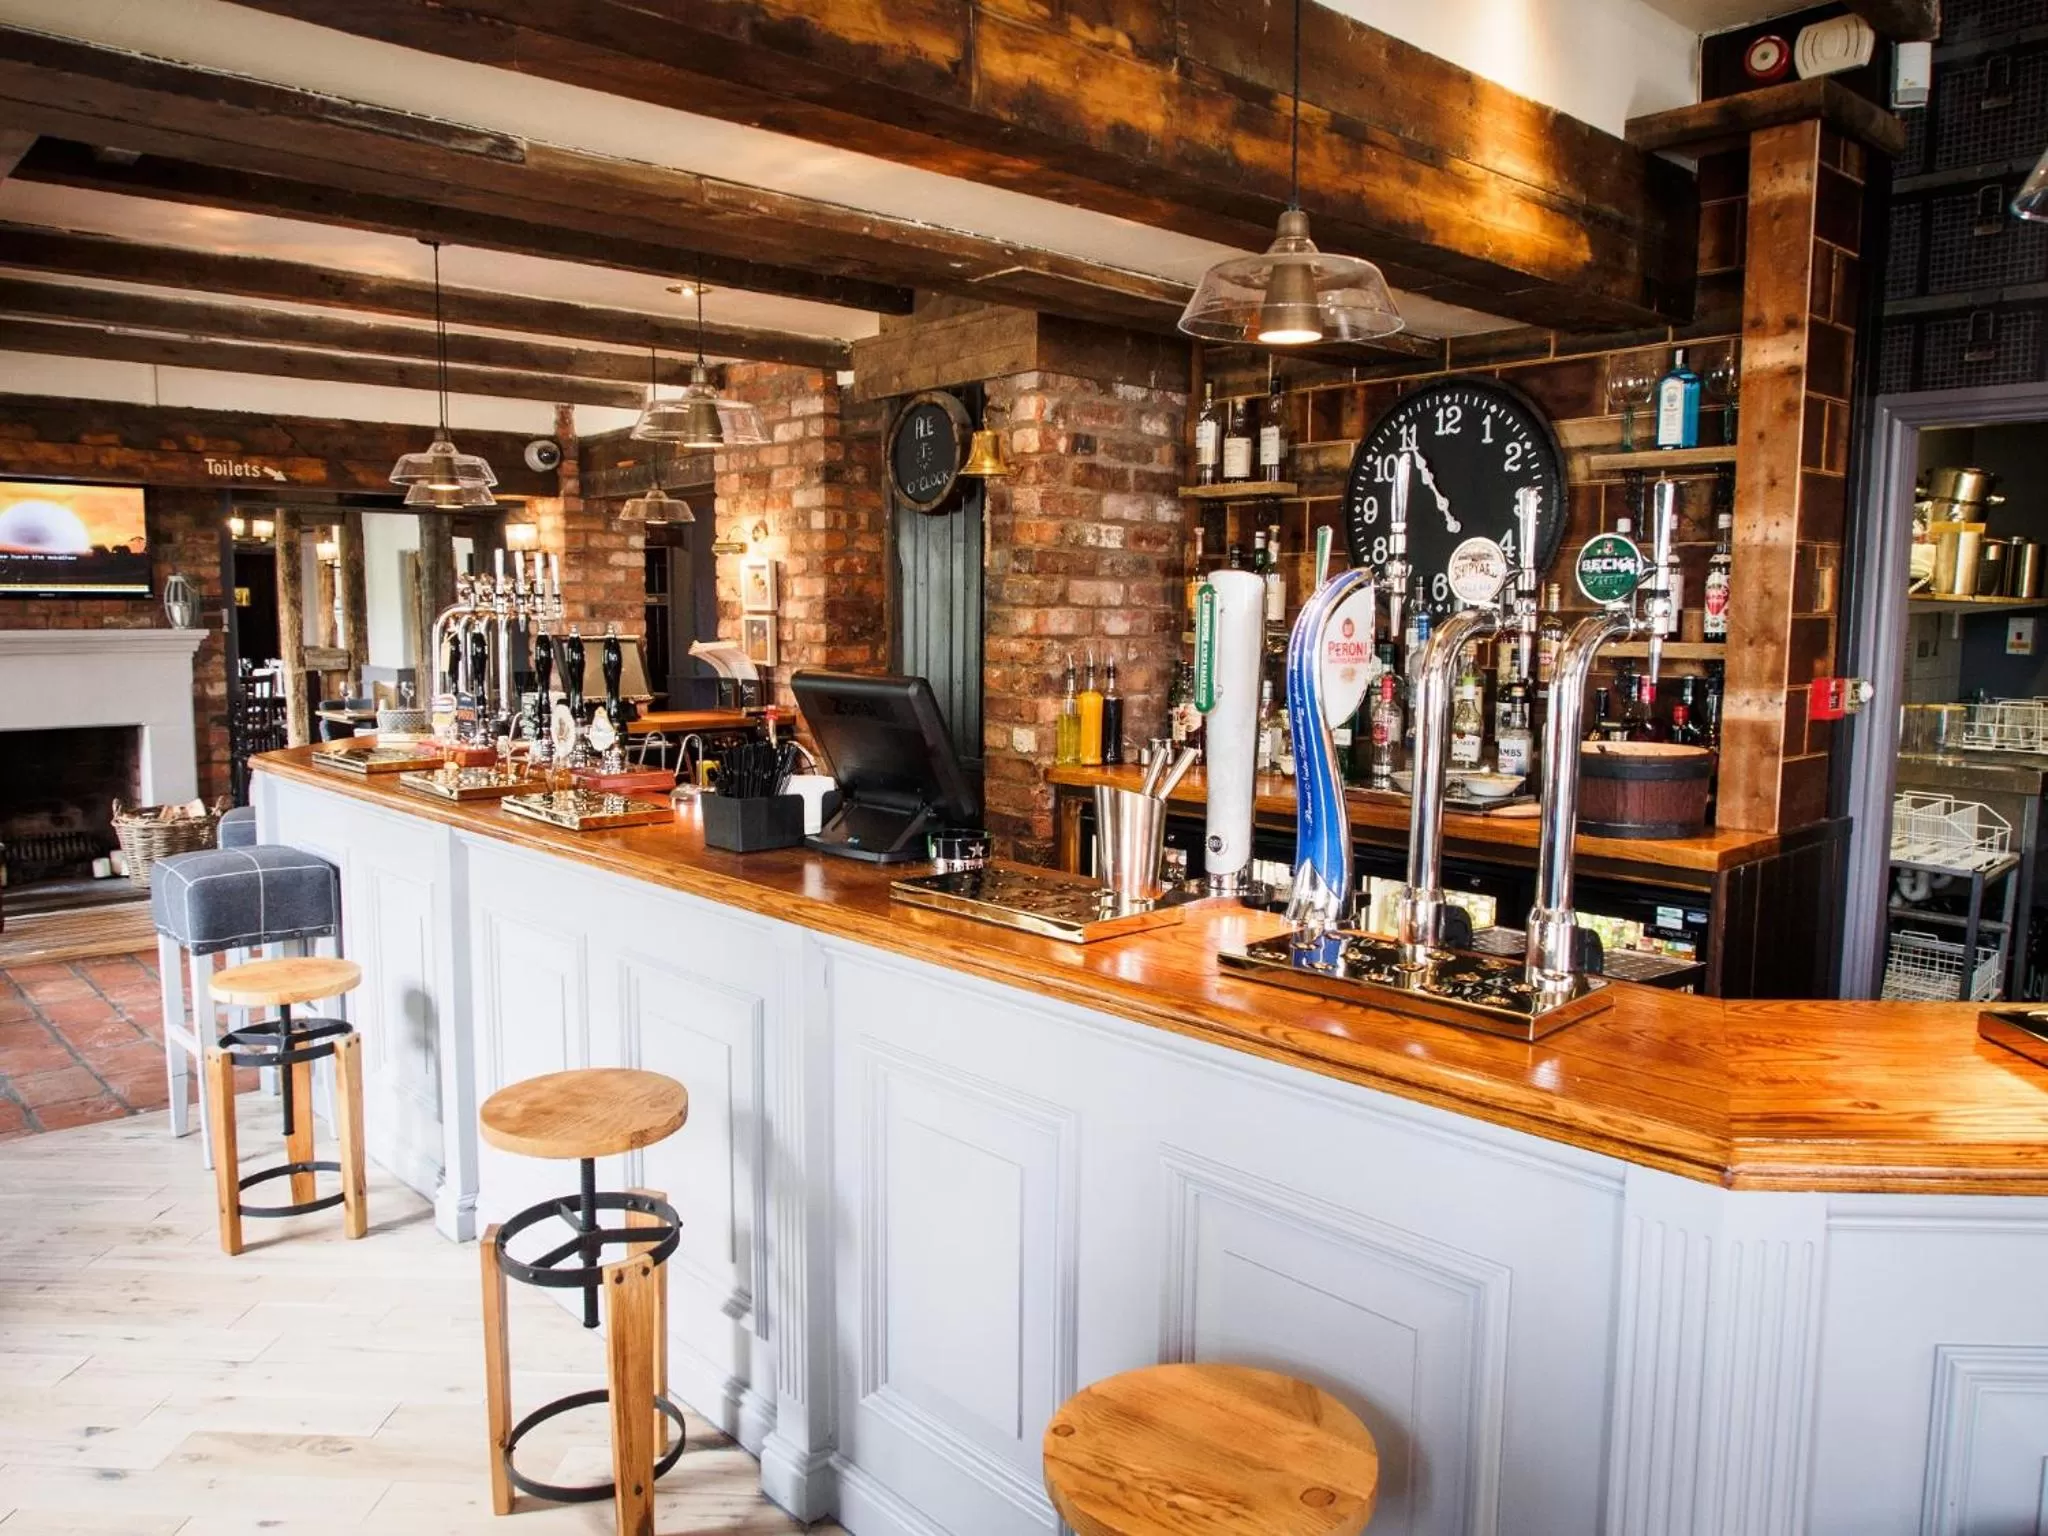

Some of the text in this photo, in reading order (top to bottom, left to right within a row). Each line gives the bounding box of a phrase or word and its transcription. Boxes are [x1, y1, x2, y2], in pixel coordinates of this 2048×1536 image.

[915, 415, 935, 441] ALE
[1434, 405, 1462, 436] 12
[1481, 414, 1494, 444] 1
[1399, 423, 1420, 453] 11
[204, 458, 261, 478] Toilets
[1373, 454, 1398, 483] 10
[1503, 441, 1523, 473] 2
[1363, 496, 1379, 525] 9
[1371, 536, 1388, 565] 8
[1500, 529, 1516, 559] 4
[1431, 572, 1448, 602] 6
[1327, 641, 1368, 658] PERONI
[1499, 748, 1522, 757] AMBS
